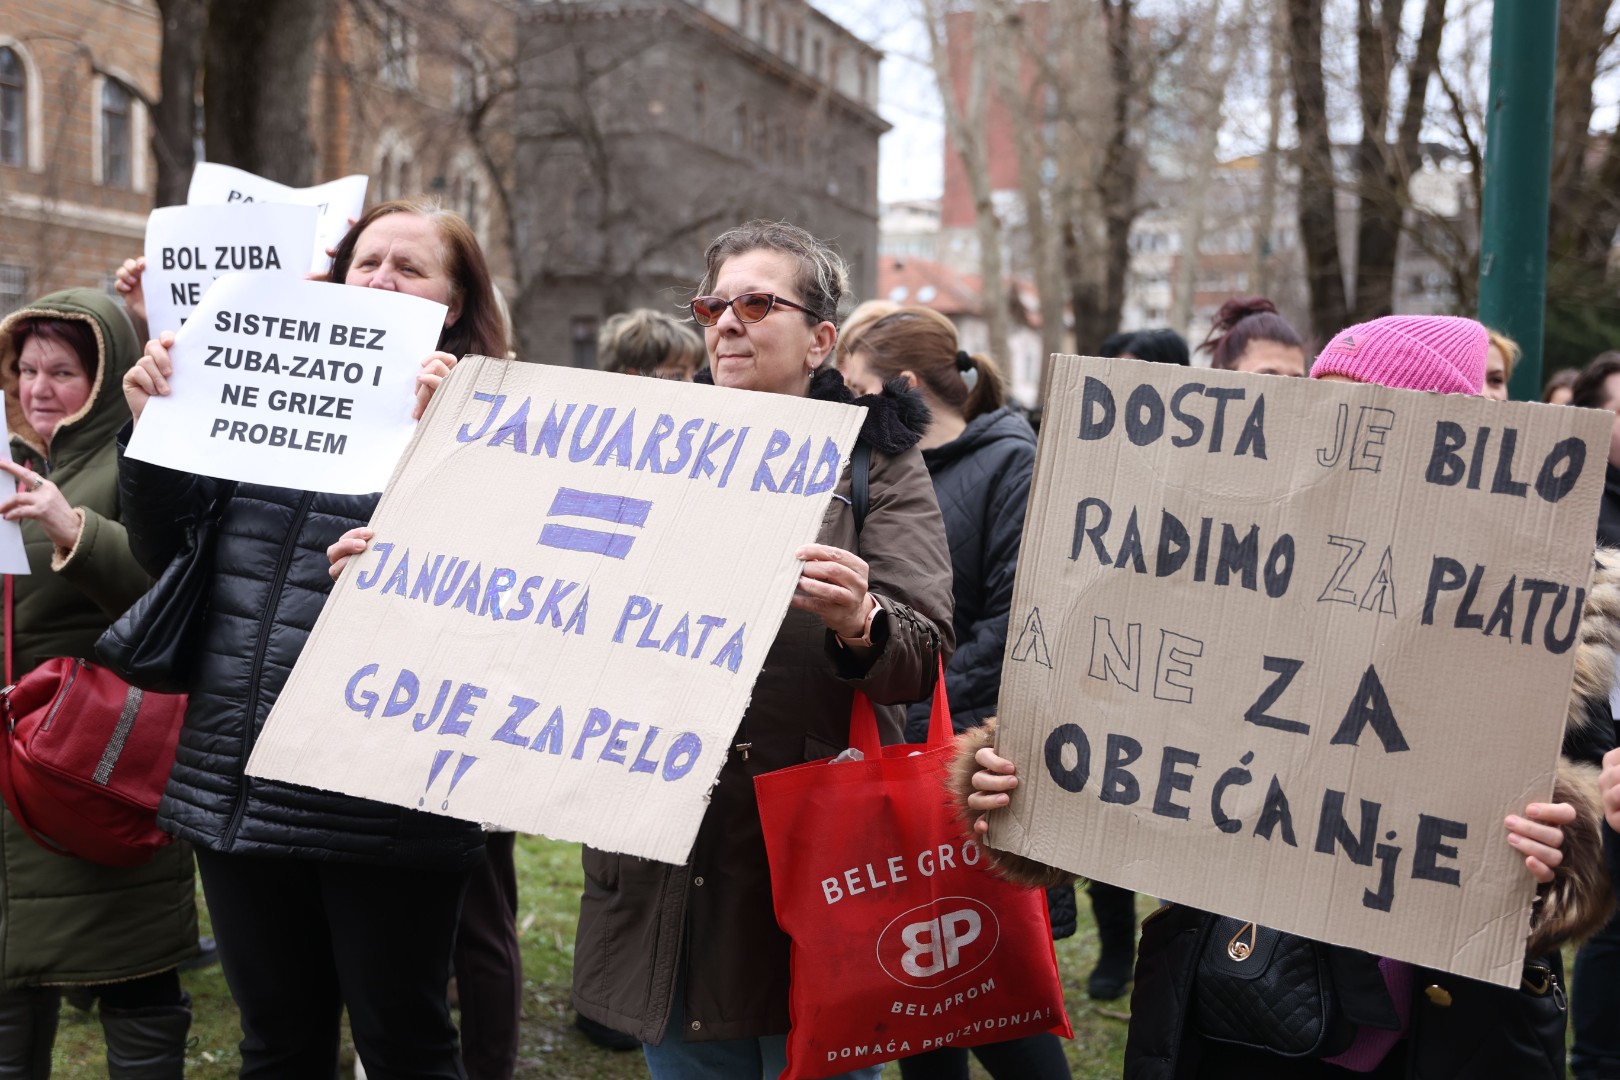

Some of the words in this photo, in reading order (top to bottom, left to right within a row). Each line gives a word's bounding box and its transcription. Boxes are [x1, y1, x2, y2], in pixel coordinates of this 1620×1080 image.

[162, 247, 207, 270] BOL
[215, 245, 281, 270] ZUBA
[171, 283, 201, 306] NE
[214, 310, 321, 343] SISTEM
[329, 324, 386, 350] BEZ
[204, 346, 364, 384] ZUBA-ZATO
[372, 366, 383, 386] I
[220, 384, 259, 408] NE
[268, 390, 354, 420] GRIZE
[210, 418, 348, 455] PROBLEM
[455, 390, 751, 489] JANUARSKI
[752, 429, 842, 497] RAD
[1077, 375, 1268, 460] DOSTA
[1316, 404, 1395, 474] JE
[1425, 420, 1587, 503] BILO
[1067, 497, 1295, 598] RADIMO
[1317, 534, 1397, 619] ZA
[1421, 554, 1585, 654] PLATU
[356, 542, 590, 636] JANUARSKA
[611, 594, 747, 674] PLATA
[1011, 606, 1053, 669] A
[1088, 616, 1203, 703] NE
[1244, 654, 1410, 753] ZA
[344, 663, 489, 737] GDJE
[490, 694, 702, 782] ZAPELO
[418, 749, 479, 811] !!
[820, 856, 908, 905] BELE
[891, 978, 995, 1017] BELAPROM
[828, 1039, 910, 1061] DOMAĆA
[923, 1008, 1051, 1049] PROIZVODNJA!
